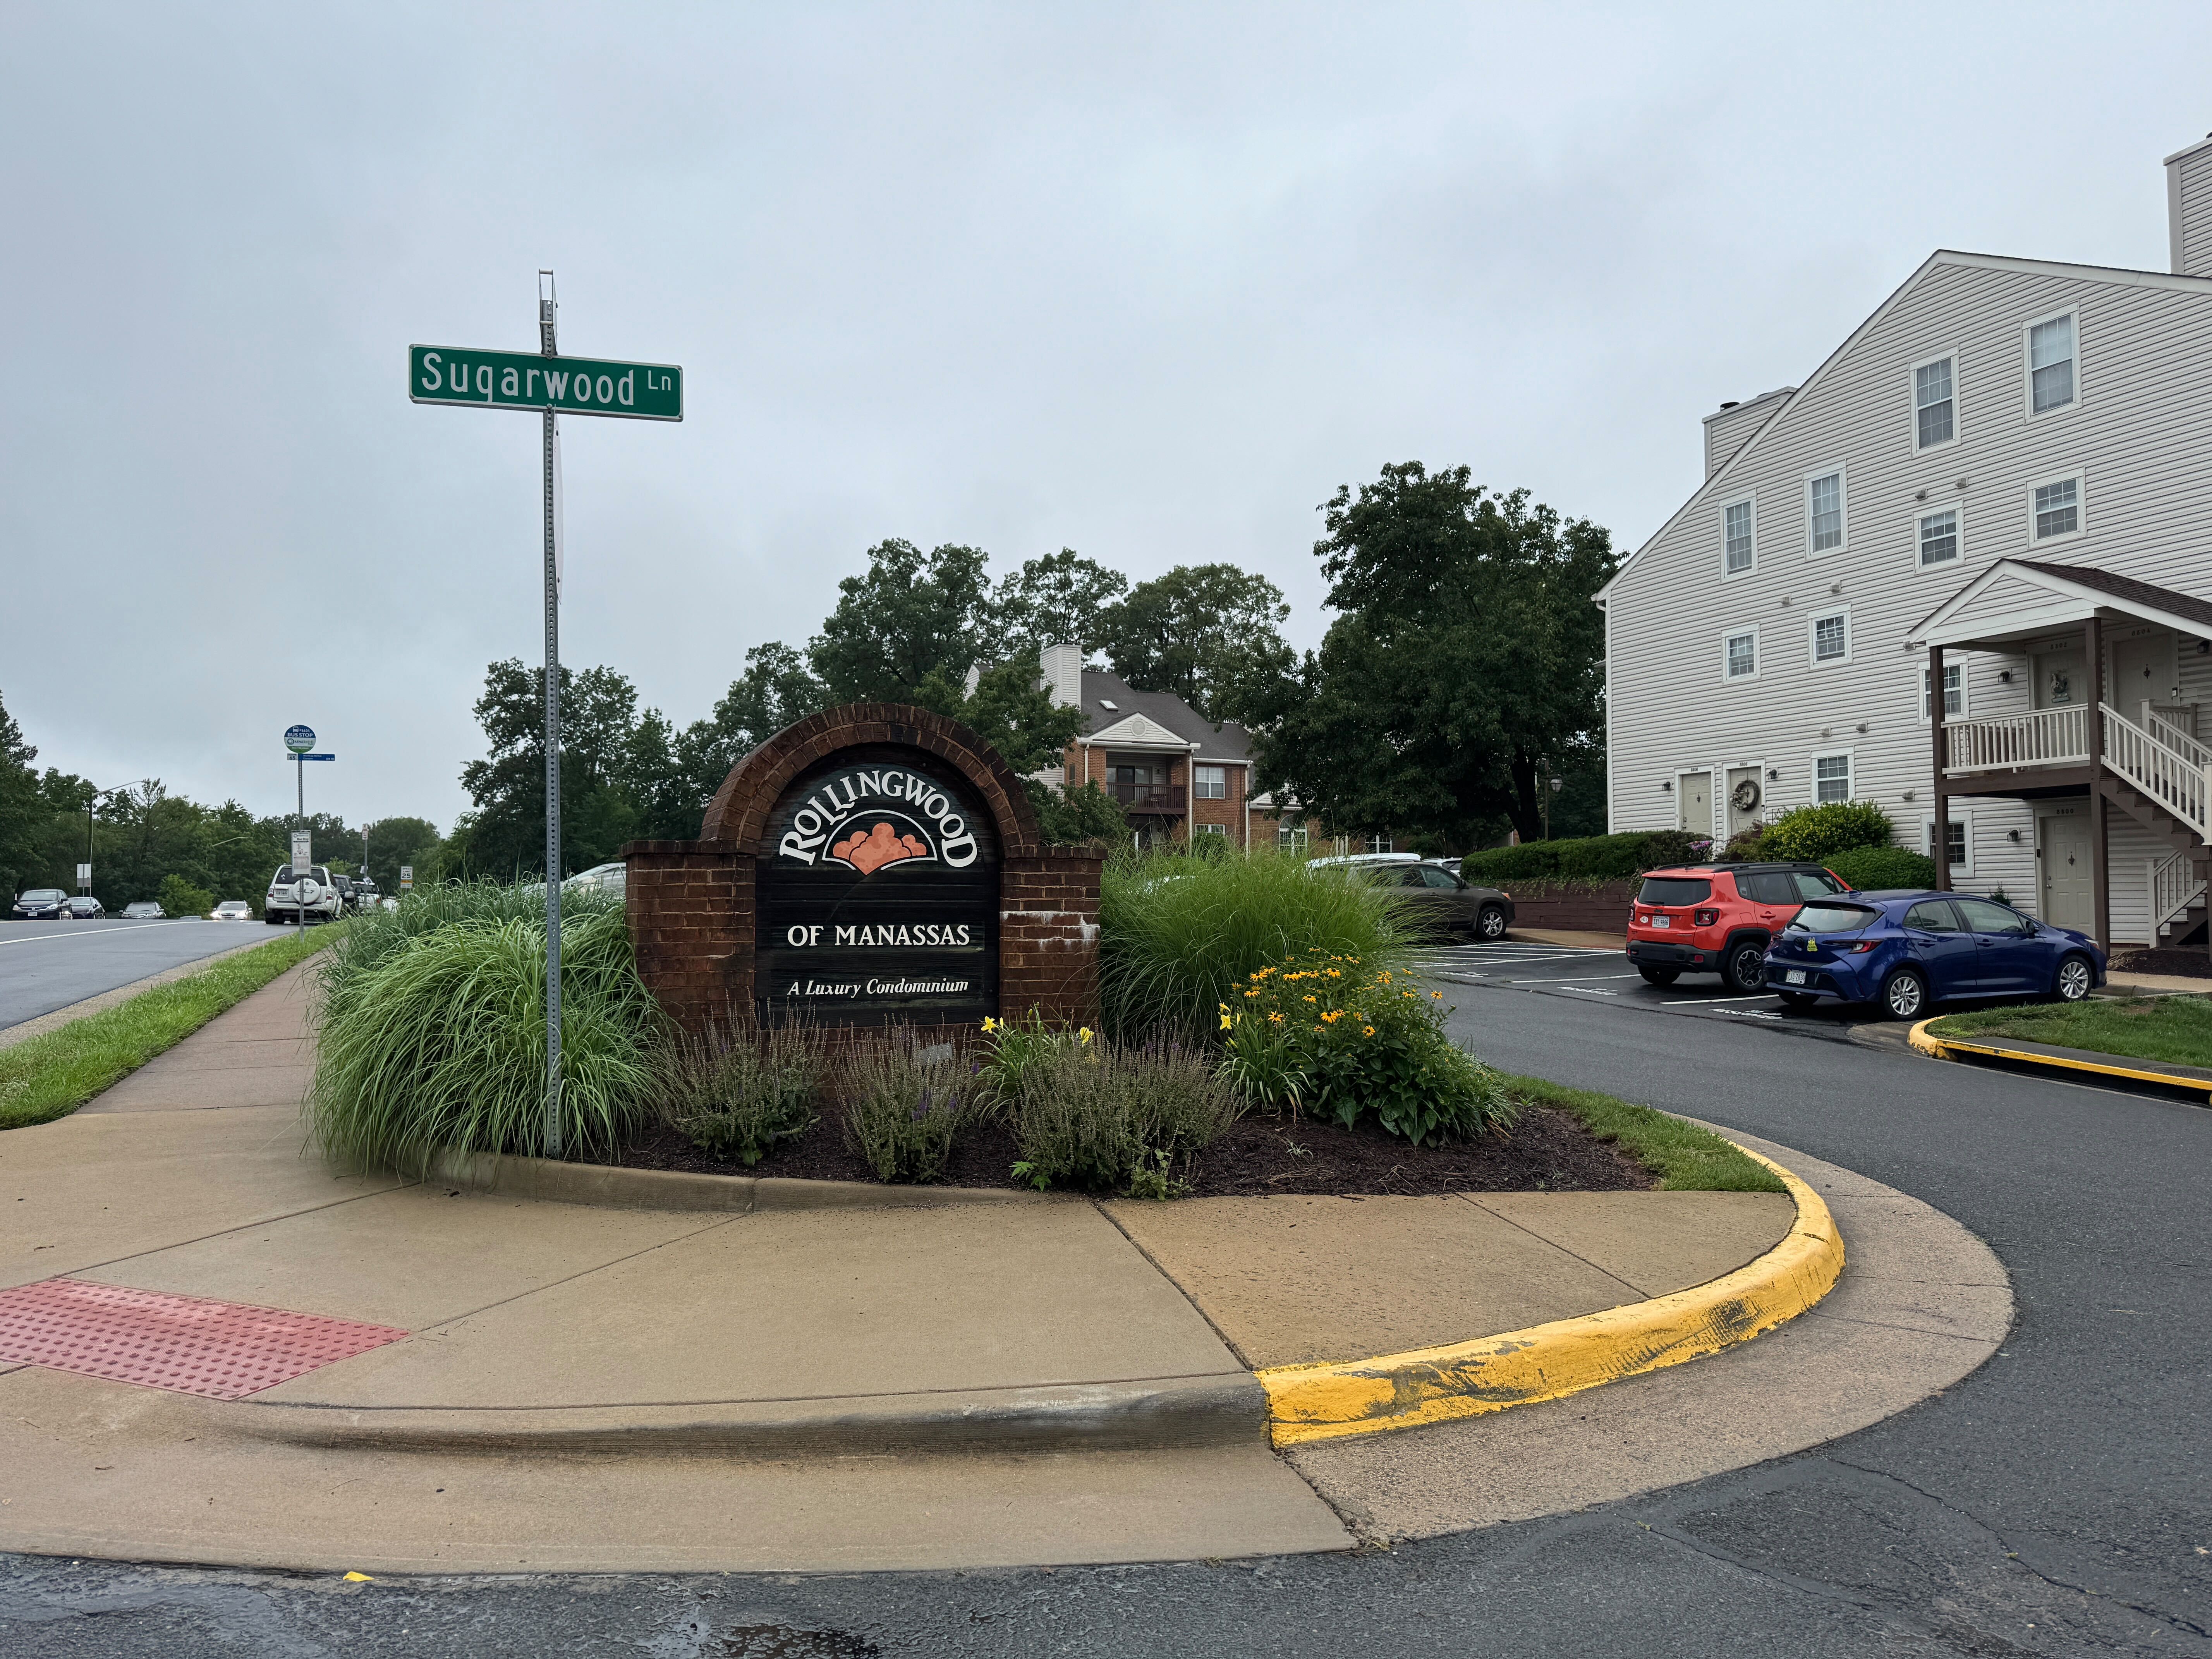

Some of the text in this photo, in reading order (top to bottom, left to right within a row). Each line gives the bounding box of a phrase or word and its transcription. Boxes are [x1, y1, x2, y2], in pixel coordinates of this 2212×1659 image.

[422, 352, 671, 405] Sugarwood Ln
[779, 770, 978, 867] ROLLINGWOOD
[788, 925, 970, 946] OF MANASSAS
[787, 978, 968, 998] A Luxury Condominium
